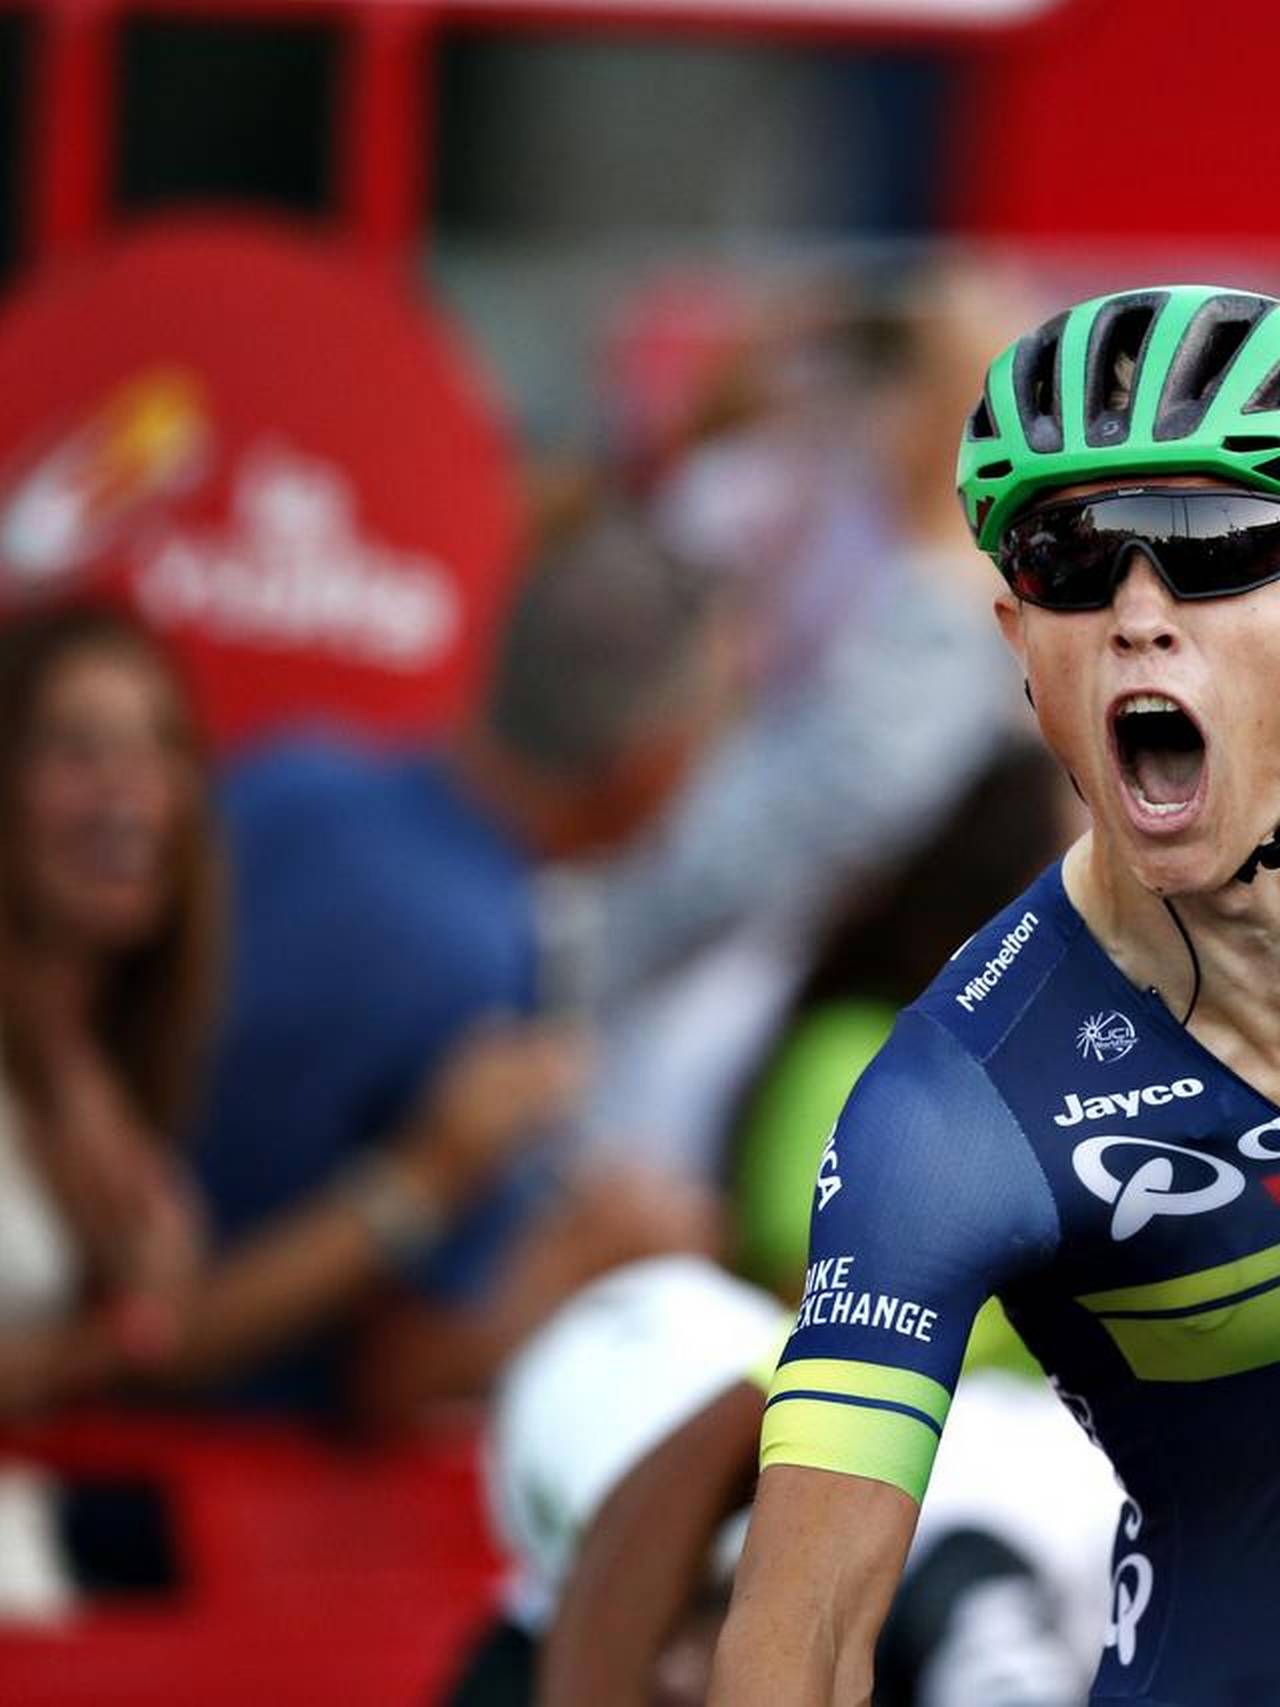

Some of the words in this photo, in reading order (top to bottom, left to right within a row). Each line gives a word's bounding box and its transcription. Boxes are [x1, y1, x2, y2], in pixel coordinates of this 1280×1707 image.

[956, 911, 1039, 1013] Mitchelton
[1054, 1077, 1205, 1127] Jayco
[803, 1256, 855, 1301] IKE
